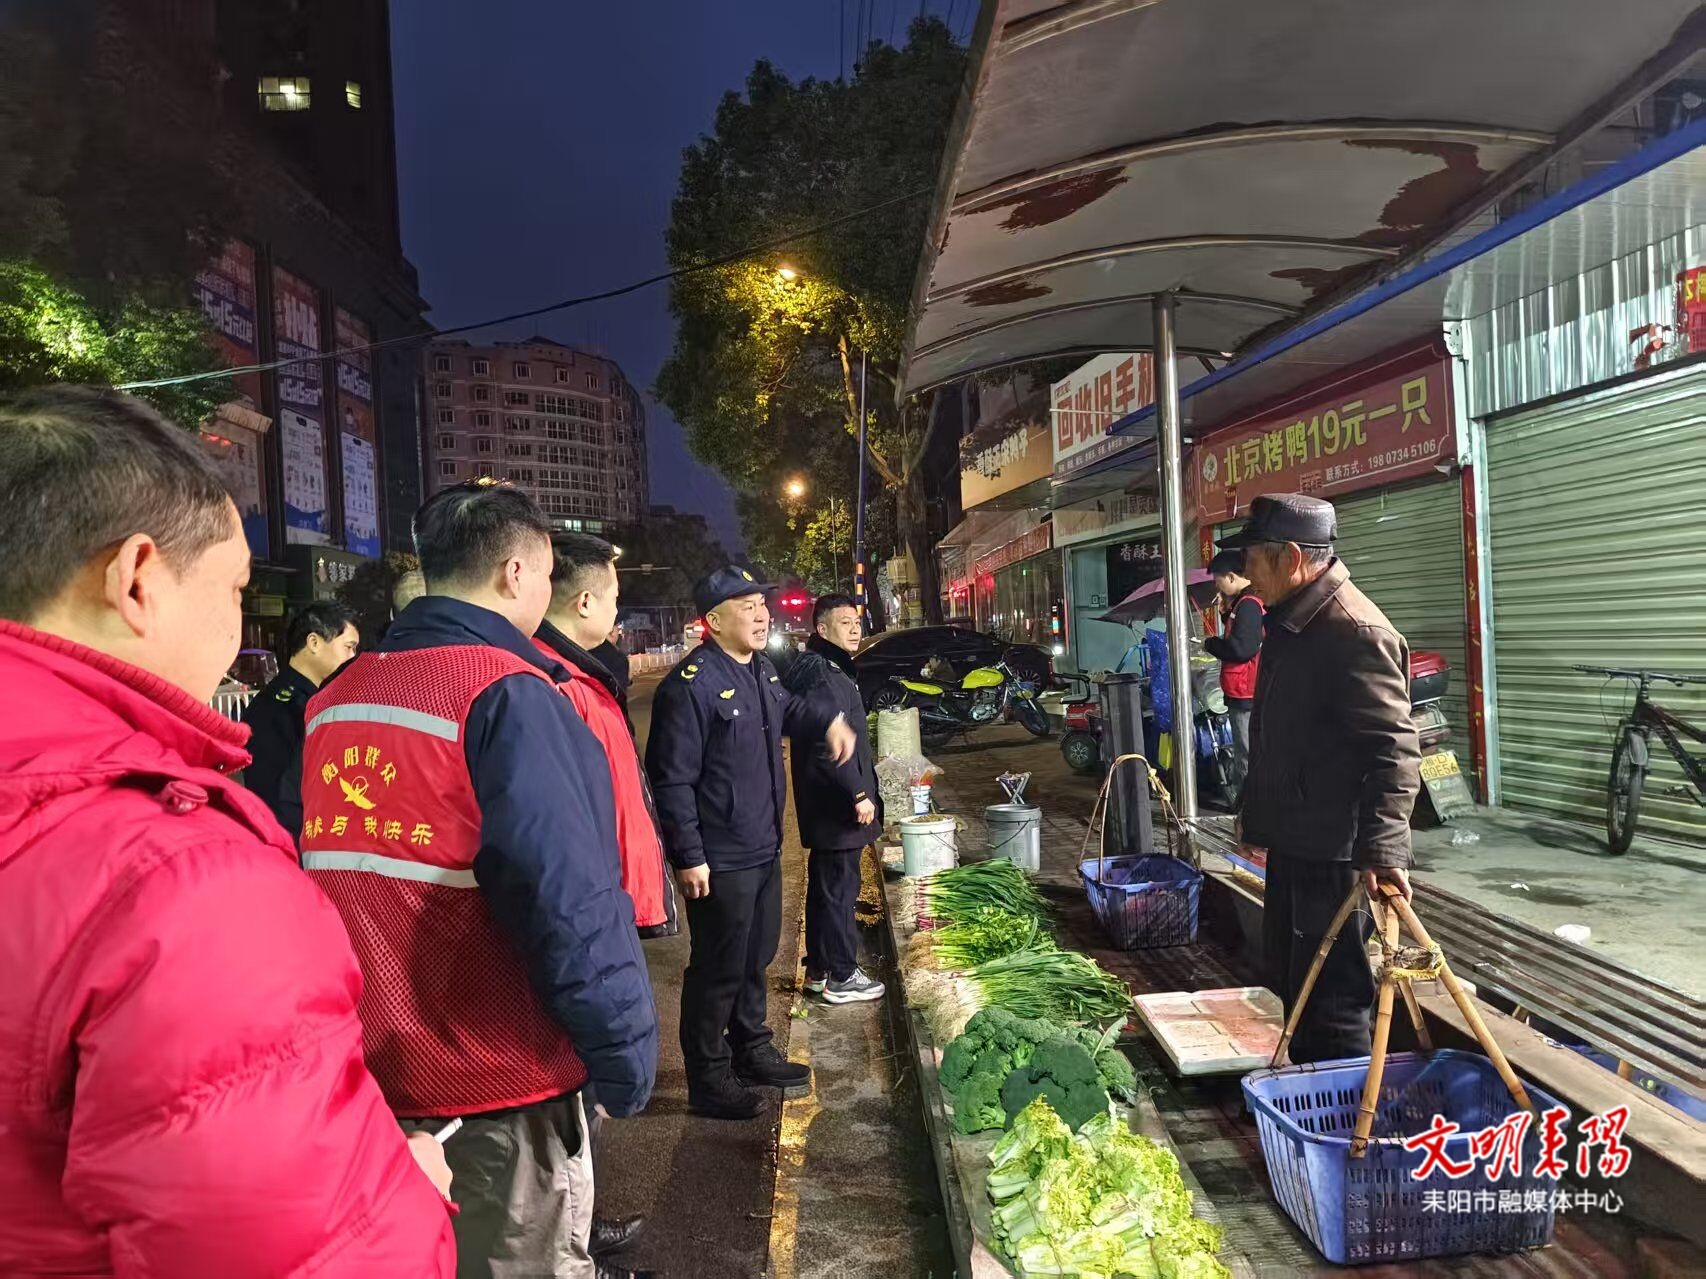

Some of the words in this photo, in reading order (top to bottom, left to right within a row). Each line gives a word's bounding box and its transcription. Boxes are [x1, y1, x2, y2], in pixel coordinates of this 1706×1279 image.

[1224, 375, 1432, 487] 北京烤鸭19元一只
[364, 815, 434, 846] 我快乐
